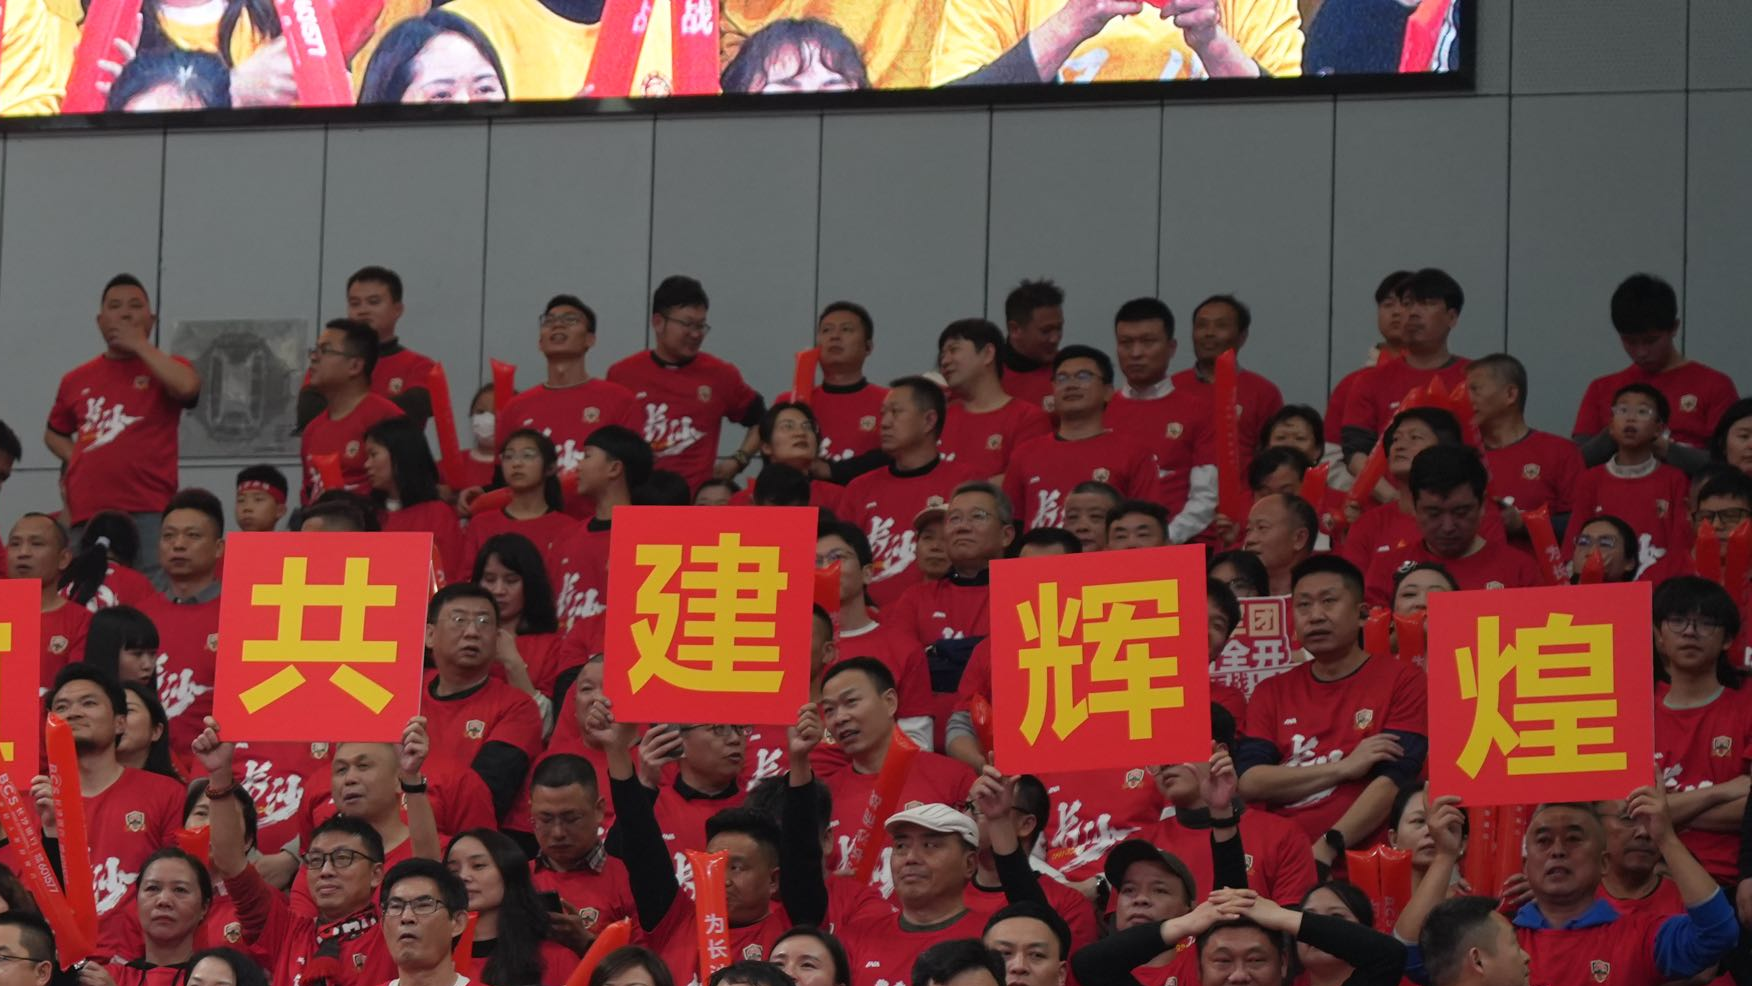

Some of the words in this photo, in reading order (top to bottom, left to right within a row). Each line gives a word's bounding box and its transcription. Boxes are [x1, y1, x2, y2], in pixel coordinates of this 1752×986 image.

[80, 396, 144, 454] 长沙
[239, 557, 396, 714] 共
[628, 533, 789, 693] 建
[1017, 579, 1184, 745] 辉
[1454, 613, 1627, 780] 煌
[239, 760, 304, 826] 长沙
[1051, 800, 1142, 872] 长沙
